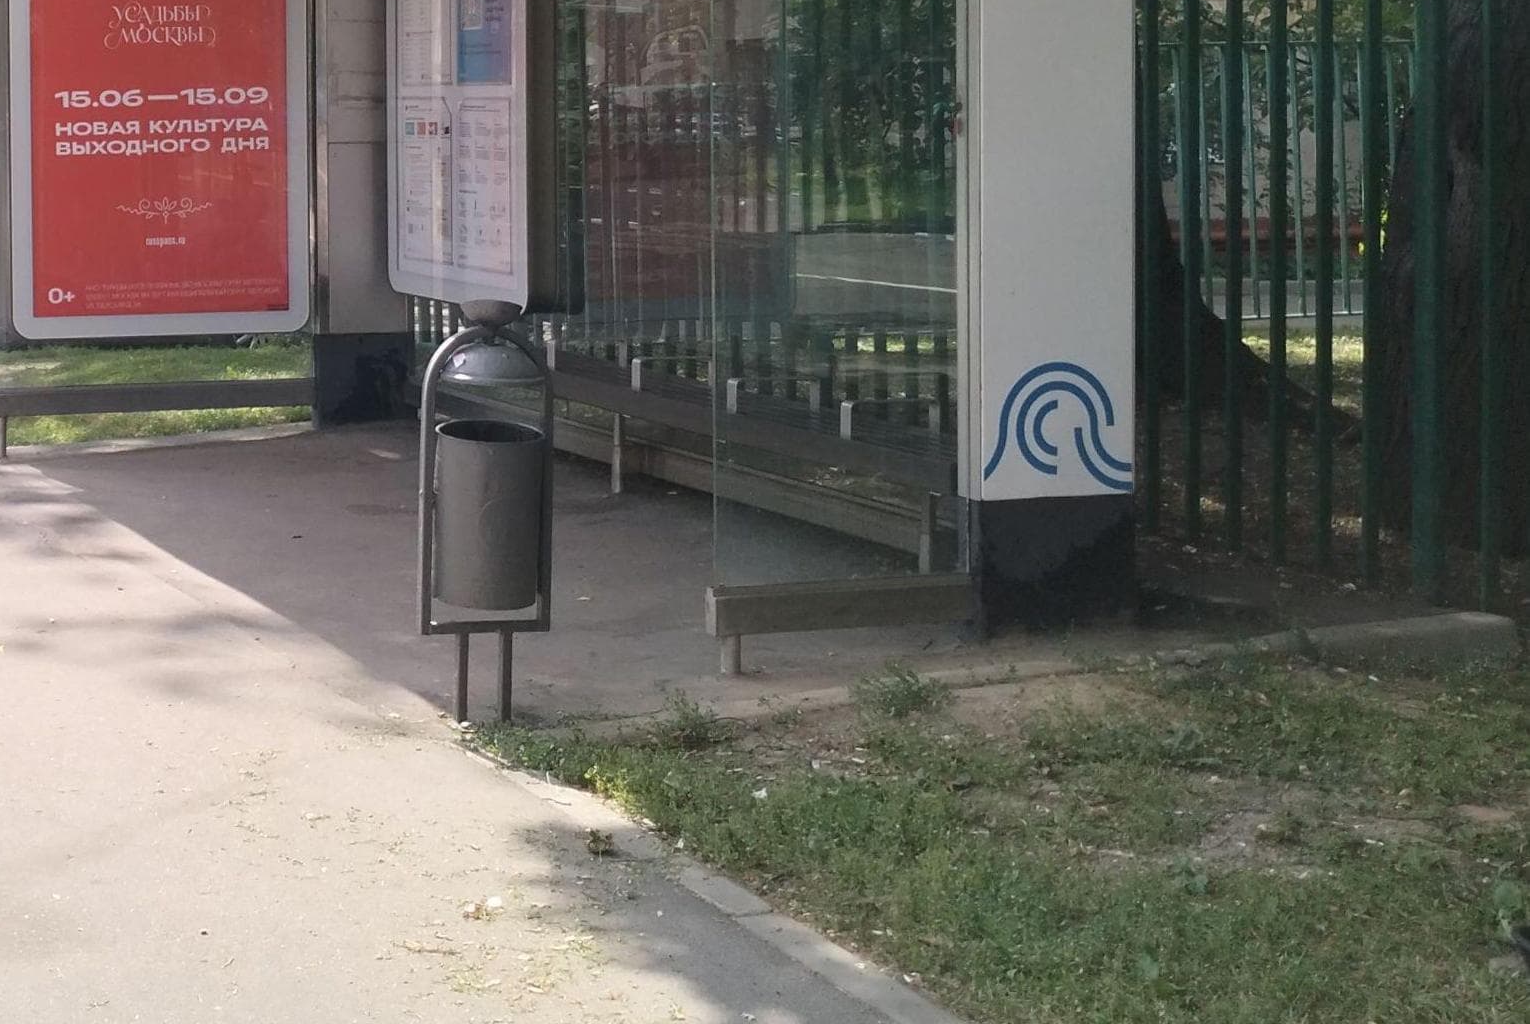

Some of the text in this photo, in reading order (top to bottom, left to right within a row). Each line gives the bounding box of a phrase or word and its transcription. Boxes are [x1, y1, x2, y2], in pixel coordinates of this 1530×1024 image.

[103, 23, 216, 50] МОСКВЫ
[55, 117, 269, 137] НОВАЯ КУЛЬТУРА
[55, 136, 270, 157] ВЫХОДНОГО ДНЯ
[48, 287, 76, 305] 0+
